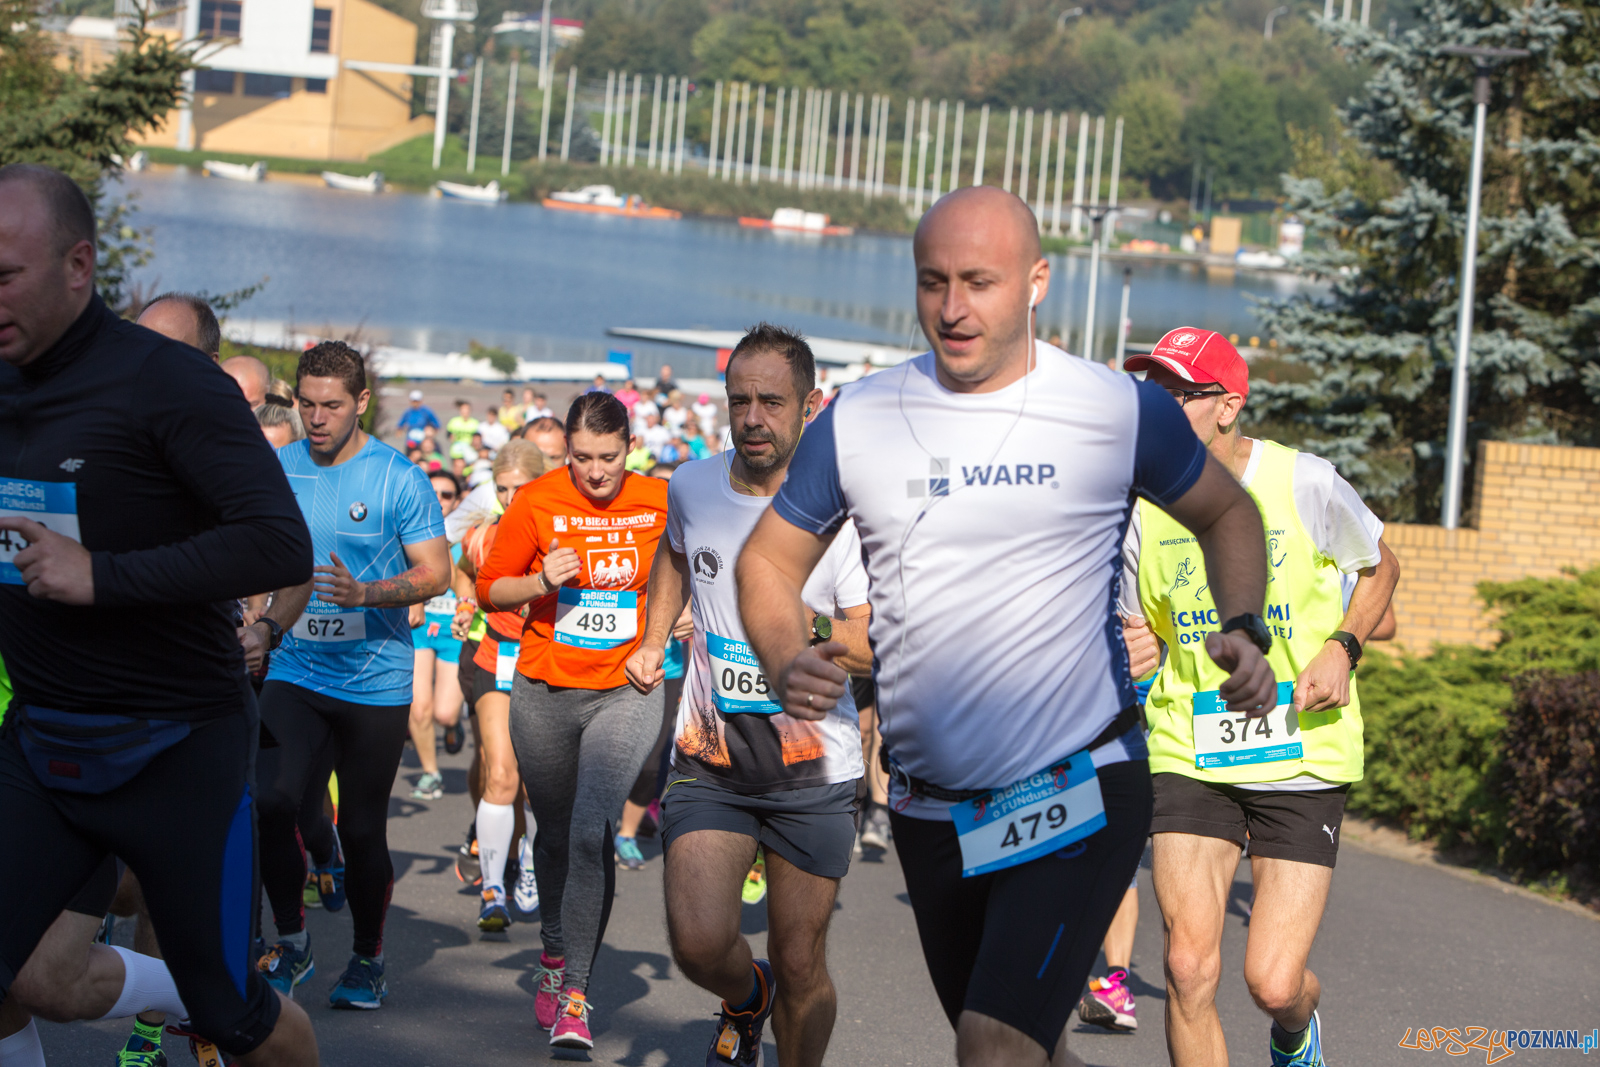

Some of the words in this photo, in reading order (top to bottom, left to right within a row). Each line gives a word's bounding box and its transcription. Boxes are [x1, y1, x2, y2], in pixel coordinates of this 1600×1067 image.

[59, 458, 85, 472] 4F
[961, 464, 1055, 486] WARP
[571, 516, 583, 526] 39
[585, 517, 608, 526] BIEG
[580, 592, 619, 602] zaBIEGaj
[307, 618, 345, 637] 672
[576, 612, 616, 632] 493
[723, 642, 753, 656] zaBIE
[730, 653, 760, 666] FUNdu
[722, 667, 770, 694] 065
[1219, 714, 1273, 744] 374
[989, 771, 1056, 808] zaBIEGa
[1000, 803, 1067, 849] 479
